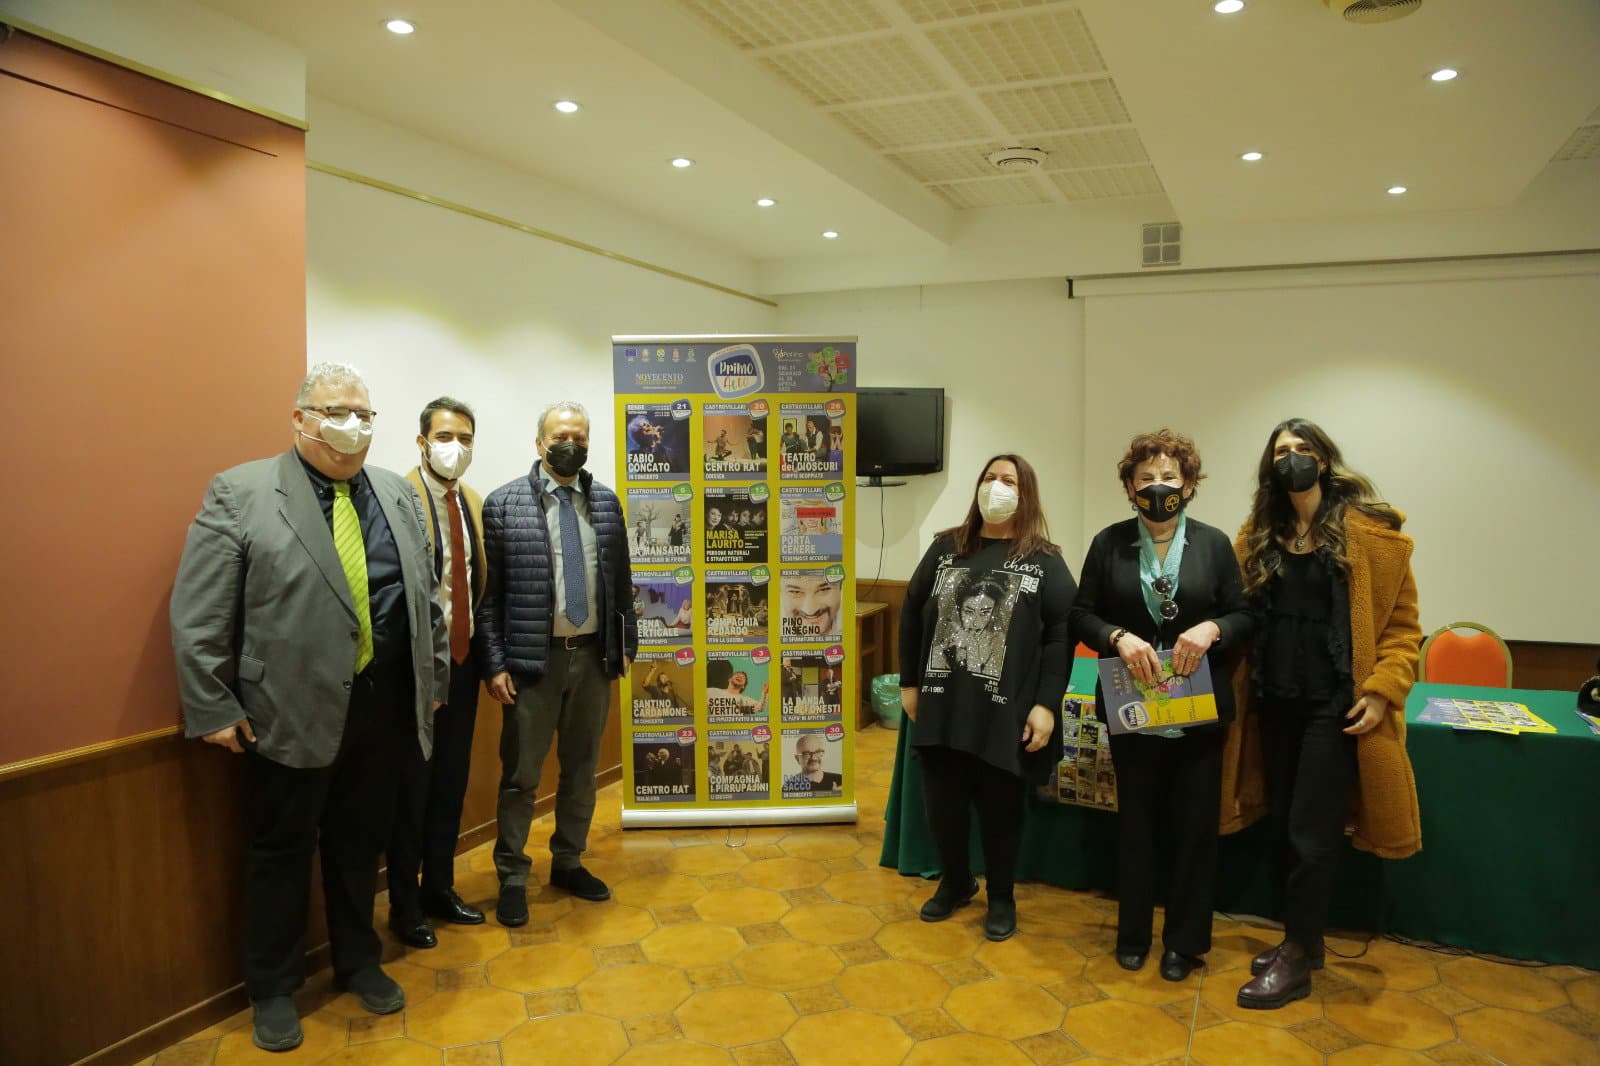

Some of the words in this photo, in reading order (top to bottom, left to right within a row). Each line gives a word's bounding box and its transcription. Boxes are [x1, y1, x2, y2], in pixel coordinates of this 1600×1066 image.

[628, 454, 654, 463] FABIO
[782, 453, 815, 462] TEATRO
[628, 463, 670, 472] CONCATO
[706, 463, 740, 472] CENTRO
[744, 463, 760, 472] RAT
[782, 463, 794, 472] dei
[798, 462, 838, 471] DIOSCURI
[706, 530, 739, 539] MARISA
[706, 539, 743, 548] LAURITO
[782, 536, 810, 544] PORTA
[645, 546, 691, 555] MANSARDA
[782, 545, 816, 554] CENERE
[1004, 554, 1044, 576] choose
[637, 620, 660, 628] CENA
[707, 617, 759, 627] COMPAGNIA
[638, 629, 679, 637] ERTICALE
[783, 626, 820, 635] INSEGNO
[633, 699, 671, 708] SANTINO
[708, 698, 736, 706] SCENA
[783, 697, 793, 706] LA
[796, 696, 824, 705] BANDA
[634, 708, 687, 717] CARDAMONE
[709, 706, 755, 715] VERTICALE
[809, 704, 840, 714] ONESTI
[710, 775, 760, 784] COMPAGNIA
[636, 786, 670, 794] CENTRO
[673, 785, 689, 794] RAT
[784, 783, 811, 791] SACCO
